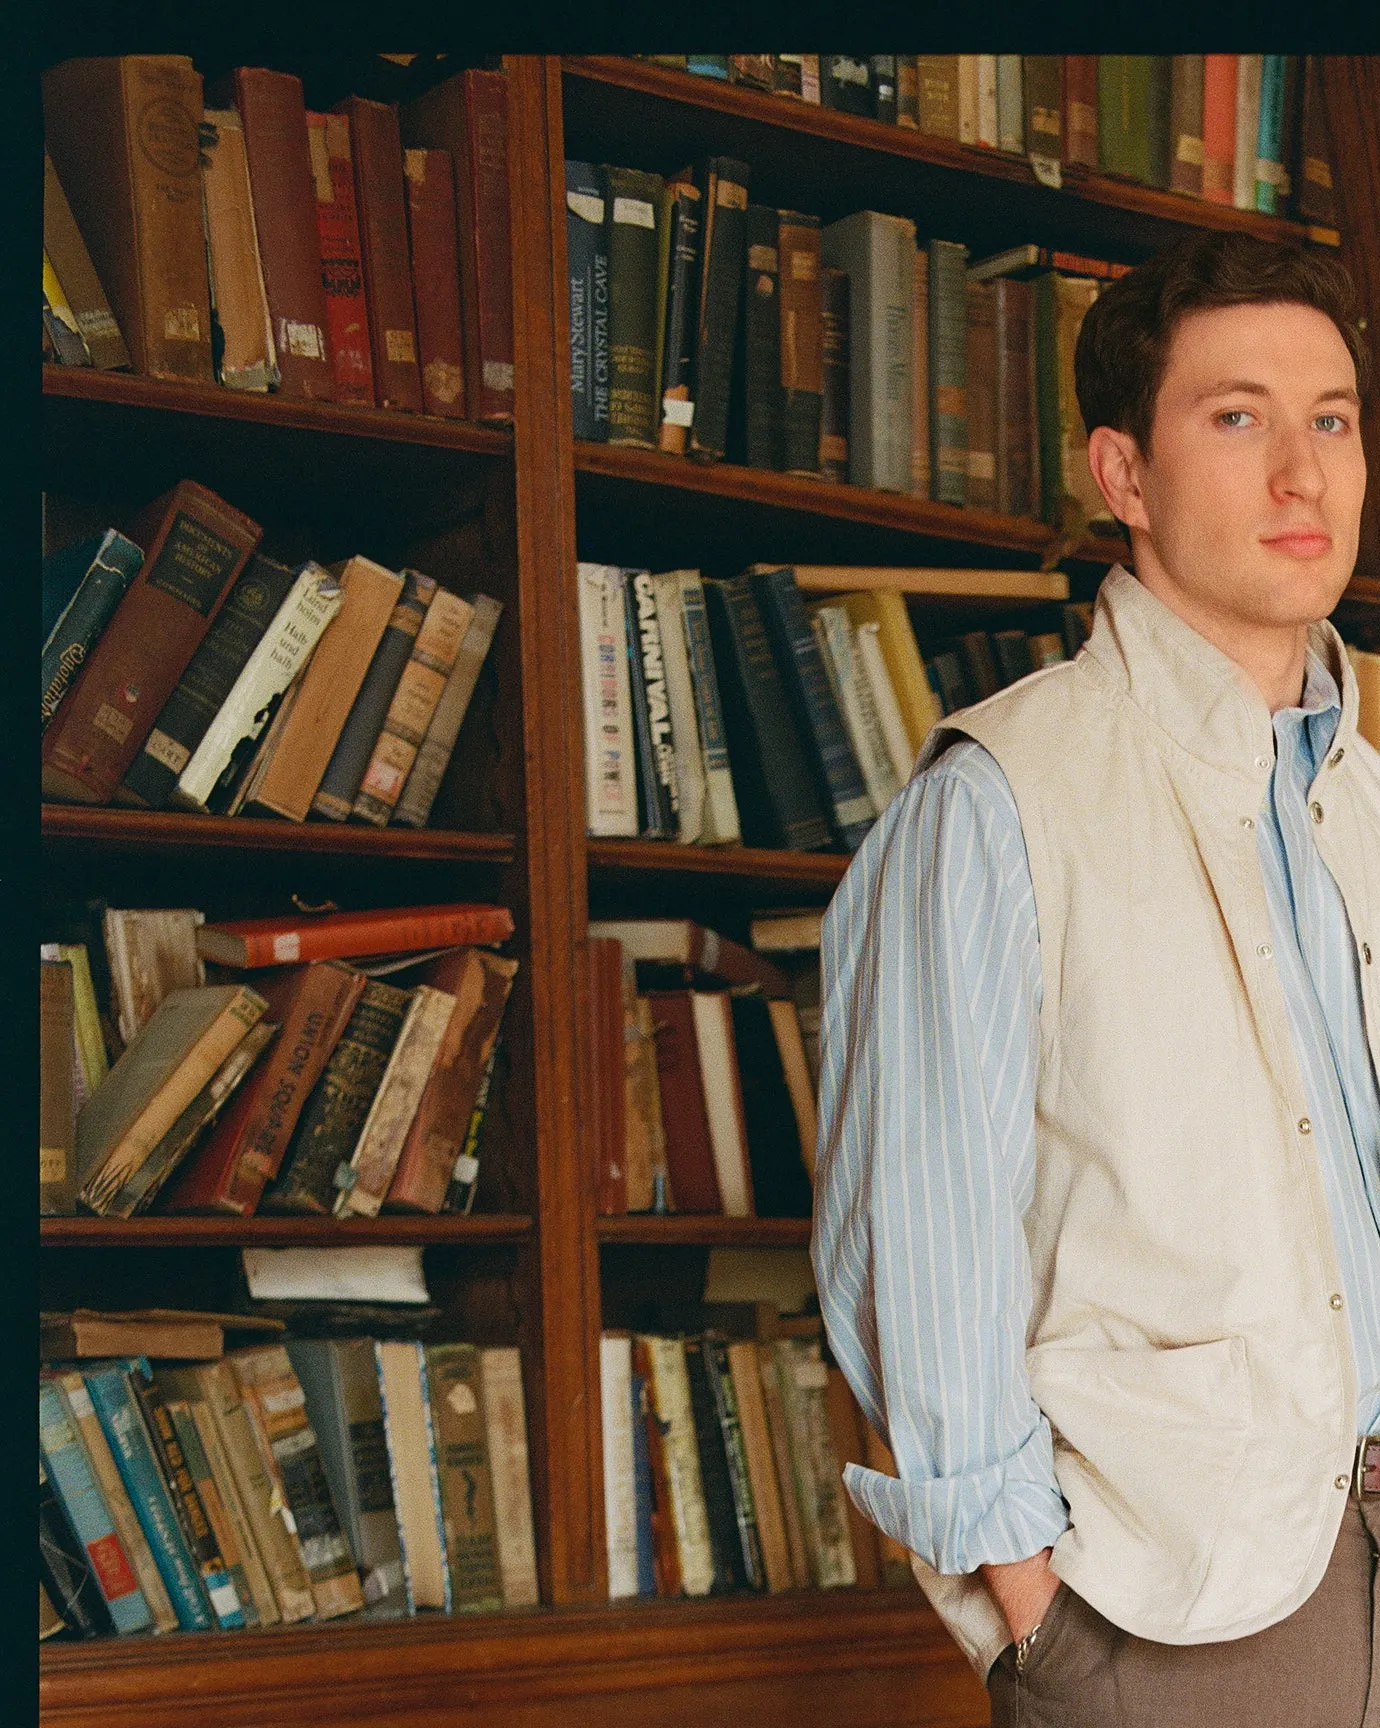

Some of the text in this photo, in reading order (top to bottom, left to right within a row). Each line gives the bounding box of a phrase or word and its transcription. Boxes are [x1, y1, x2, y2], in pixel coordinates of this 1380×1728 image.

[571, 276, 587, 394] Mary Stewart
[594, 254, 608, 421] THE CRYSTAL CAVE
[269, 648, 293, 669] halb
[280, 638, 300, 656] und
[284, 622, 308, 645] Halb
[634, 573, 672, 746] CARNIVAL
[253, 1011, 322, 1156] UNION SQUARE
